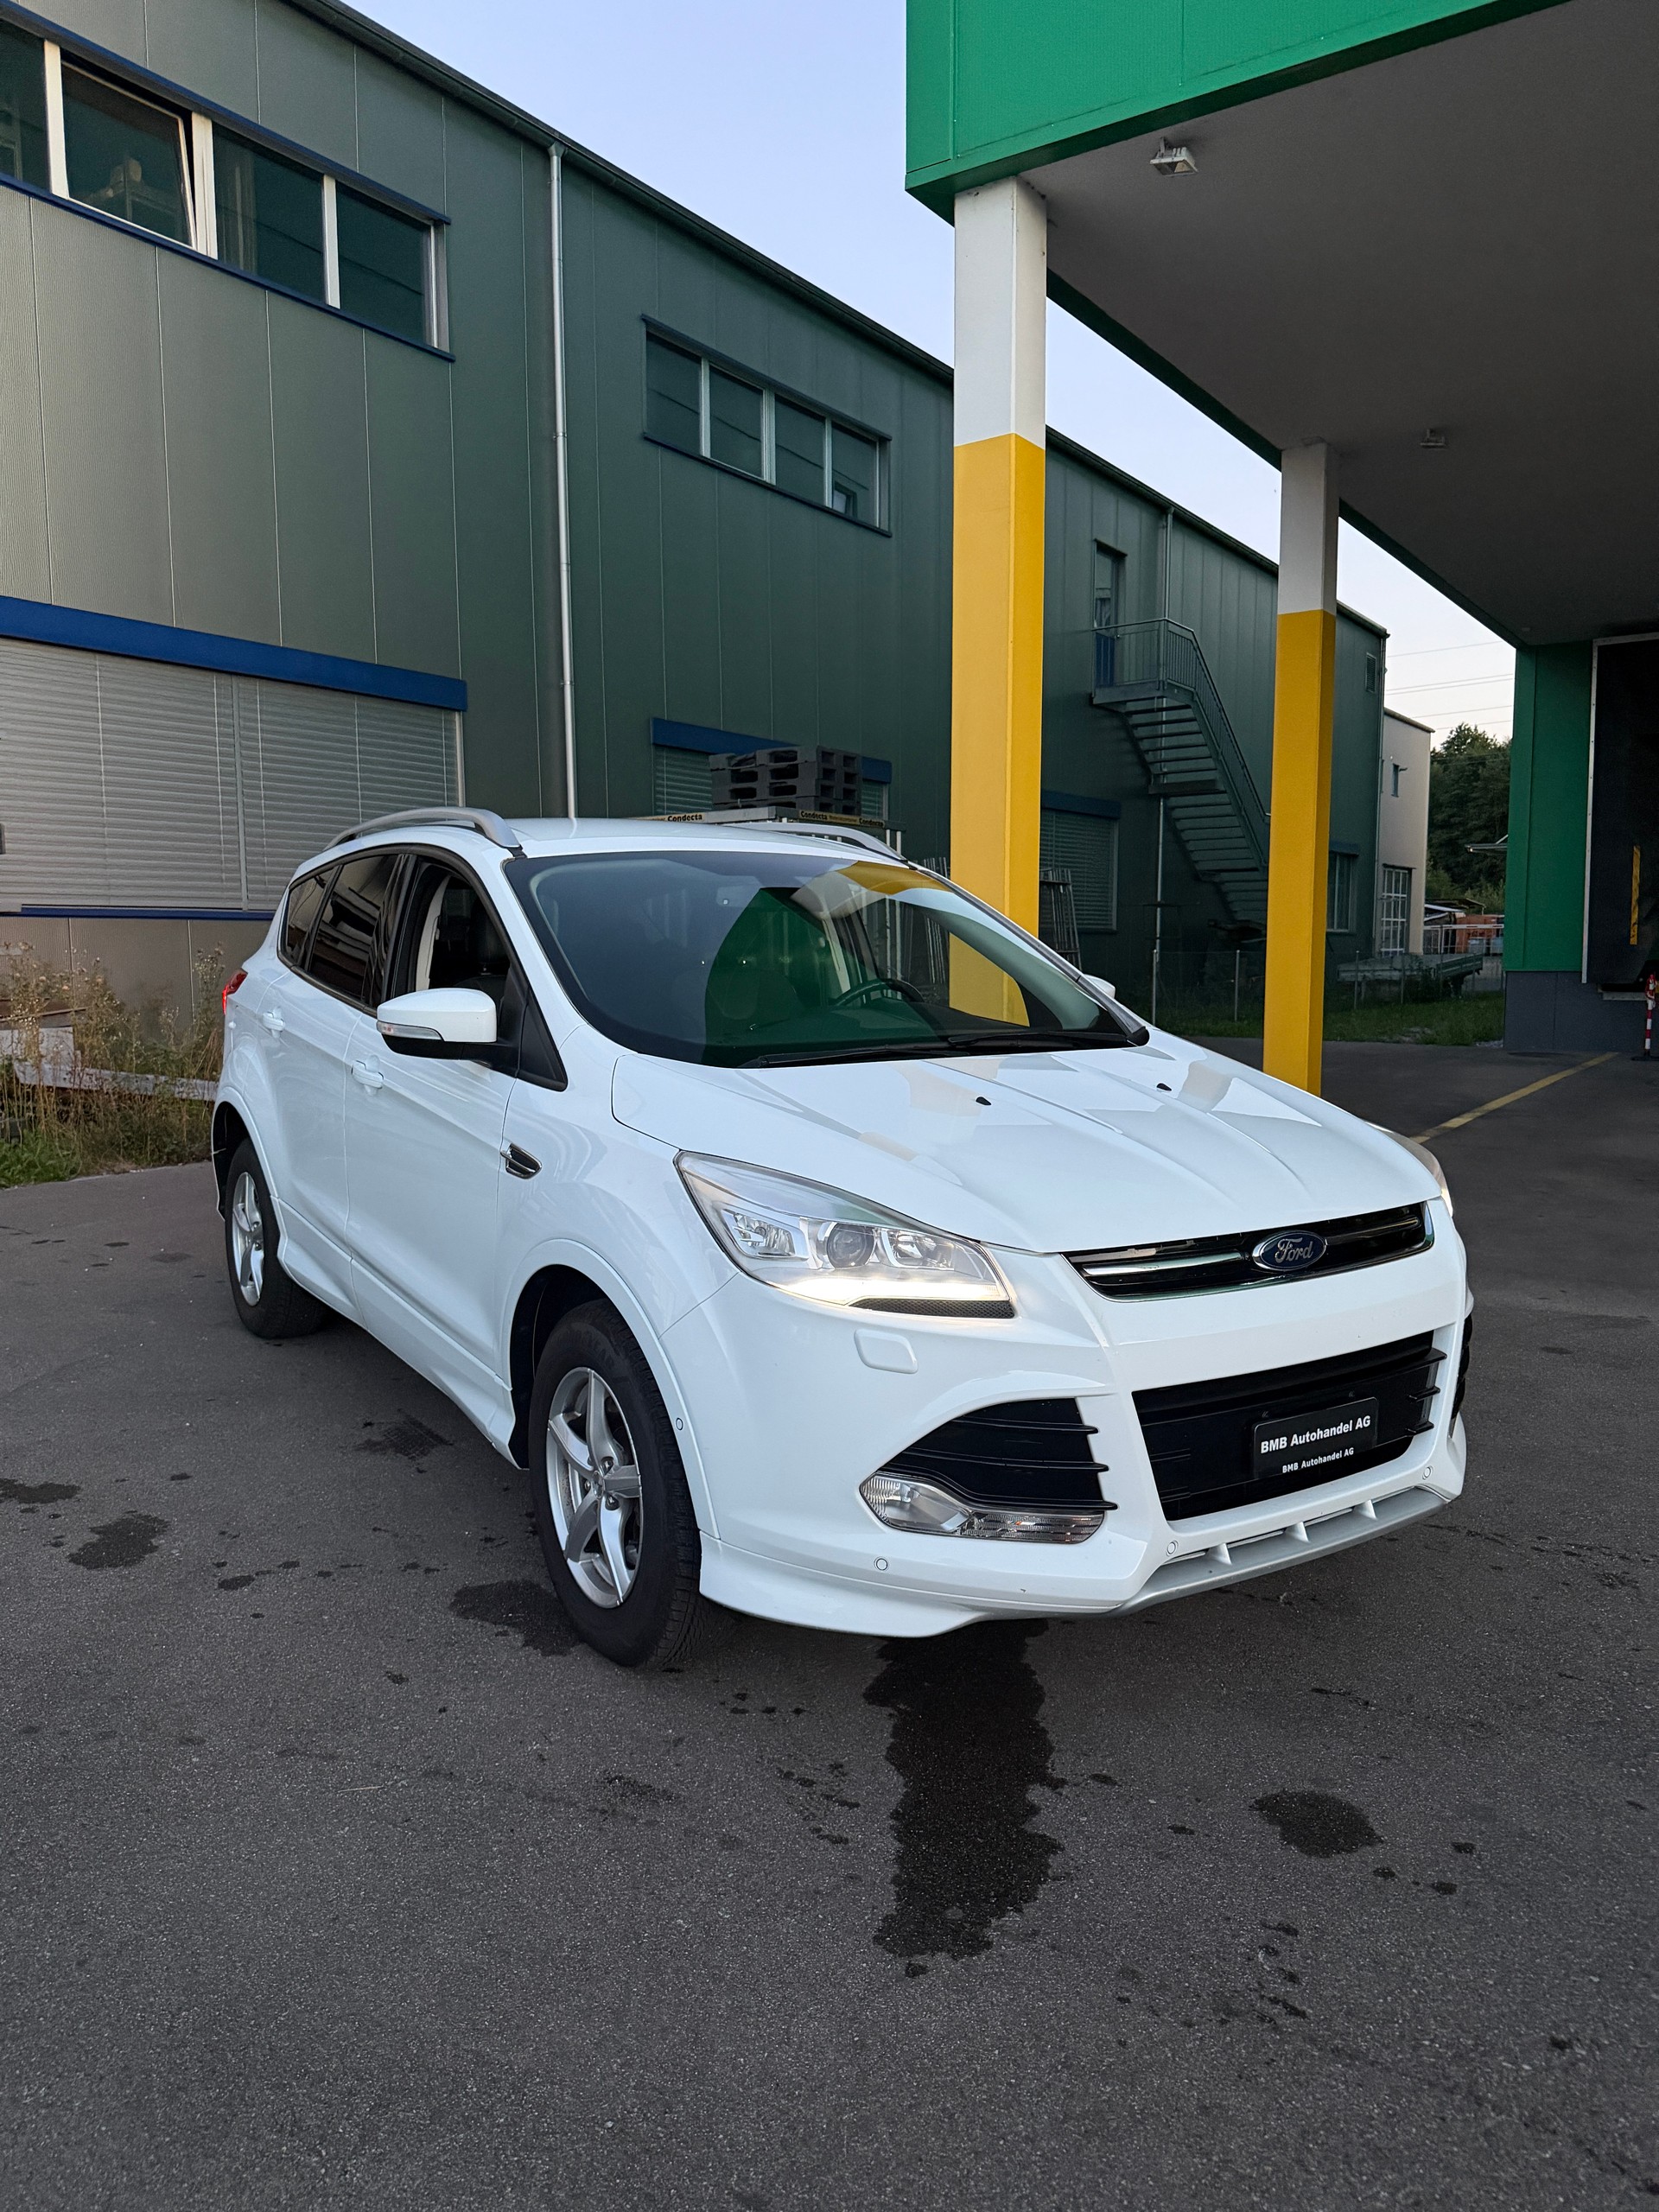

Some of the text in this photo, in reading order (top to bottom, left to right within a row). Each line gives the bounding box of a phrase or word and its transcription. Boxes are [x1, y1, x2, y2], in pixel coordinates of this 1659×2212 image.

[800, 810, 828, 820] Condecta
[1274, 1237, 1313, 1263] Ford
[1260, 1415, 1371, 1454] BMB Autohandel AG
[1282, 1447, 1354, 1473] BMB Autohandel AG
